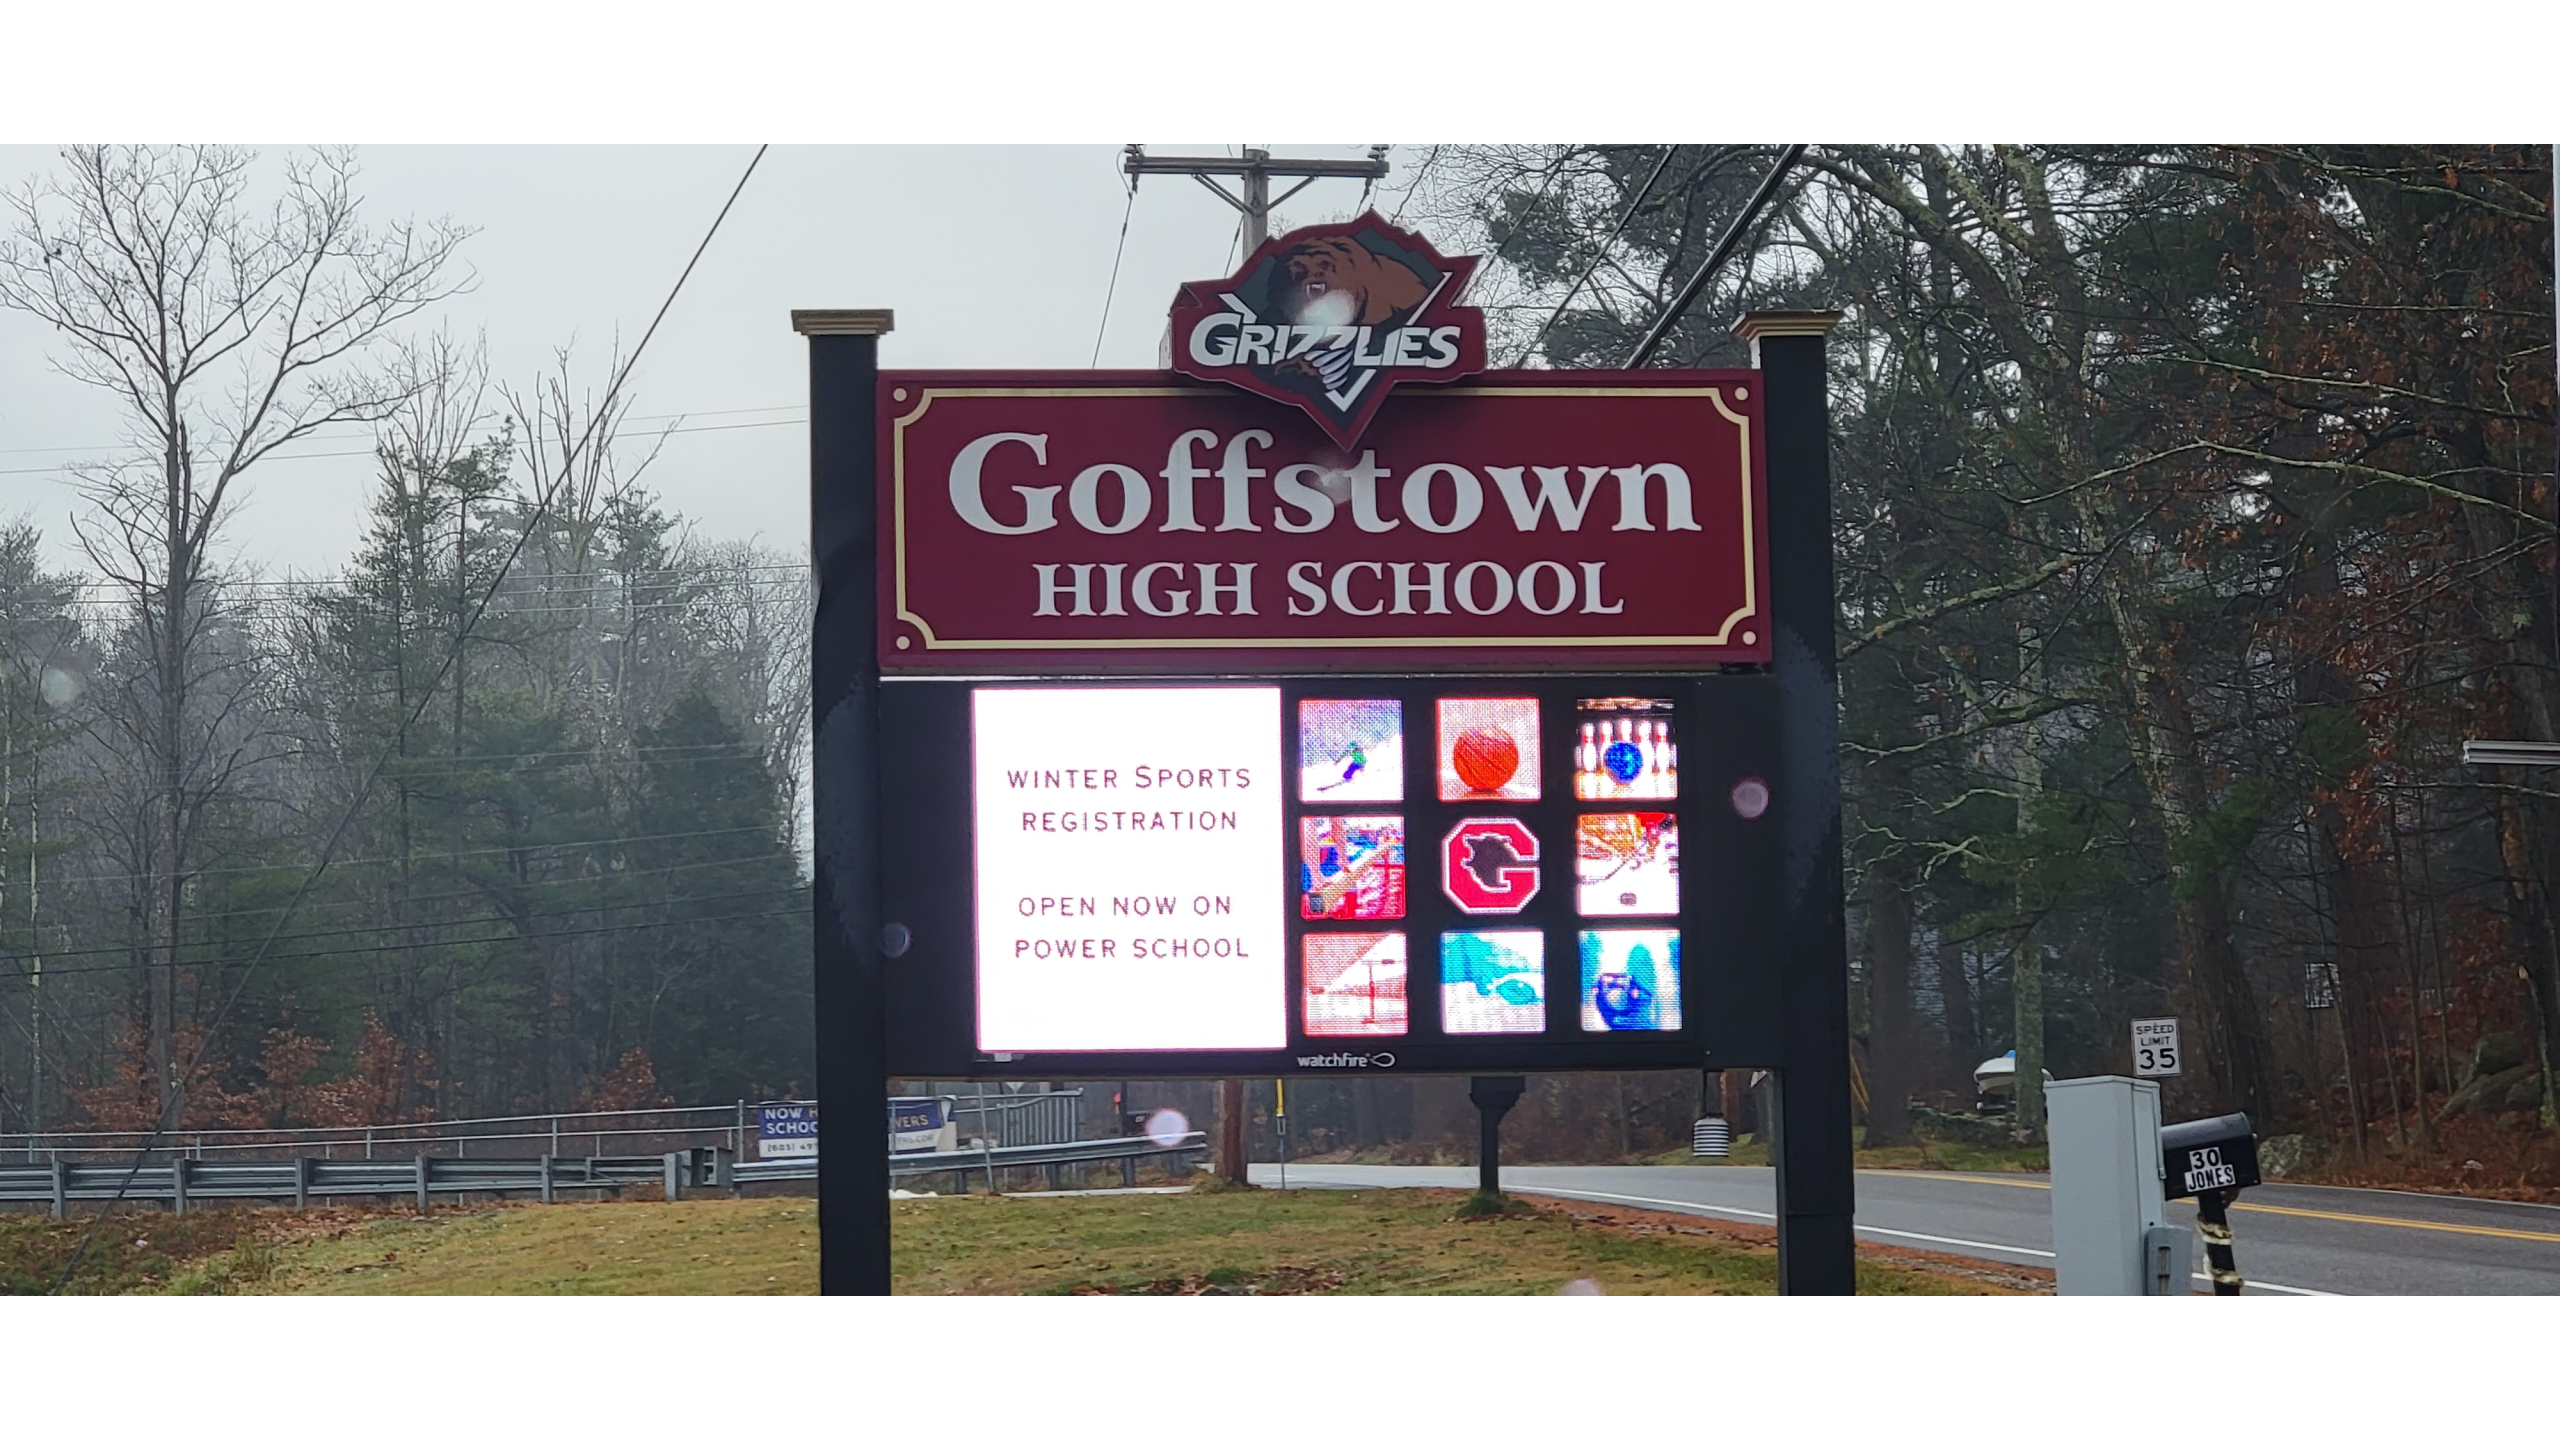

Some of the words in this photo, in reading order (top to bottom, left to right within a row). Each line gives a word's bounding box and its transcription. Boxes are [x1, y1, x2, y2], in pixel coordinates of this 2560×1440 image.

[1189, 312, 1461, 369] GRIZZLIES
[948, 429, 1702, 535] Goffstown
[1032, 562, 1260, 616] HIGH
[1286, 561, 1624, 616] SCHOOL
[1007, 769, 1117, 789] WINTER
[1135, 765, 1250, 788] SPORTS
[1022, 811, 1236, 832] REGISTRATION
[1018, 896, 1095, 917] OPEN
[1113, 896, 1176, 916] NOW
[1193, 895, 1231, 916] ON
[1015, 938, 1116, 959] POWER
[1132, 938, 1249, 959] SCHOOL
[2135, 1024, 2175, 1036] SPEED
[2140, 1036, 2171, 1047] LIMIT
[2139, 1048, 2176, 1070] 35
[764, 1107, 803, 1120] NOW
[2192, 1148, 2219, 1170] 30
[2188, 1166, 2234, 1190] JONES
